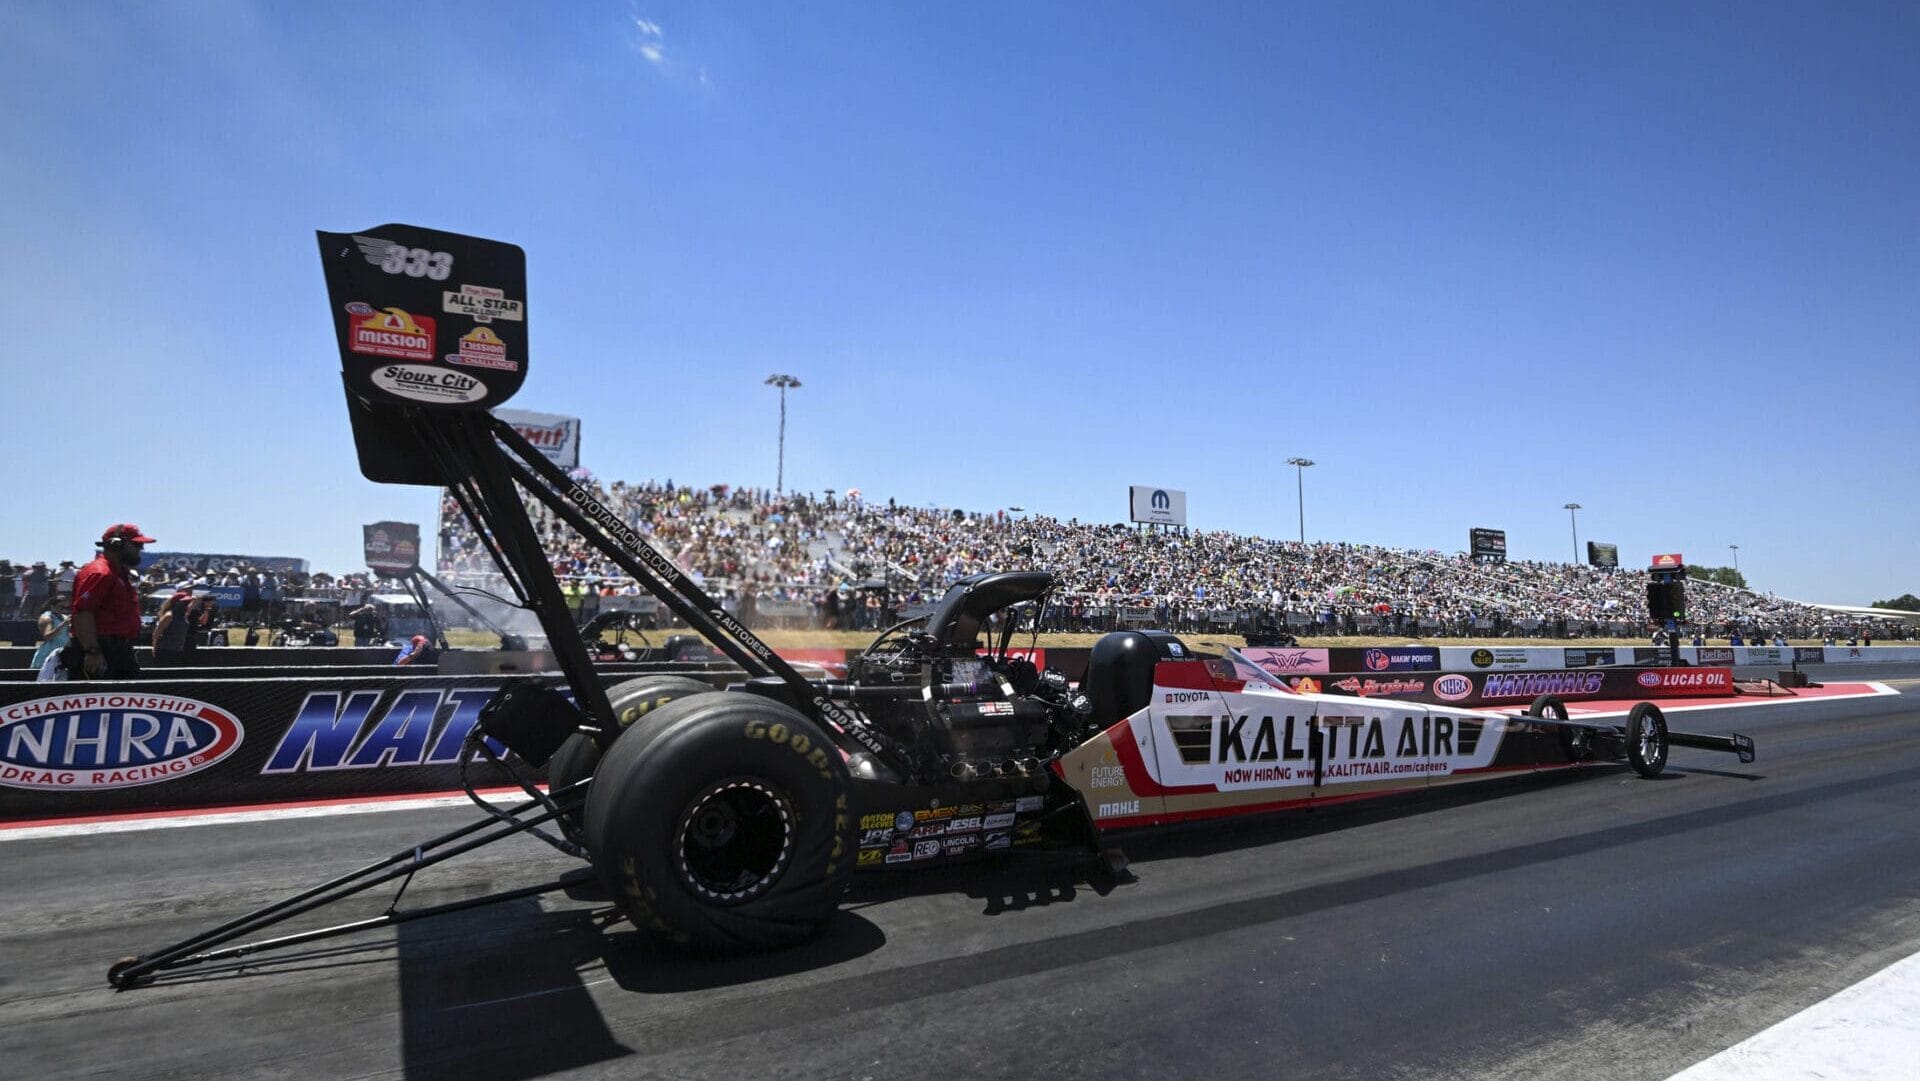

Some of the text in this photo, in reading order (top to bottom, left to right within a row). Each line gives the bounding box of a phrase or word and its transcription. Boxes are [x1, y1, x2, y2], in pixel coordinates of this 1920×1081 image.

[381, 244, 454, 280] 333
[384, 366, 478, 390] Sioux City
[567, 484, 680, 584] TOYOTARACING.COM
[723, 615, 772, 660] AUTODESK
[1441, 679, 1467, 695] NHRA
[1482, 672, 1605, 699] NATIONALS
[1663, 673, 1725, 686] LUCAS OIL
[7, 696, 197, 720] CHAMPIONSHIP
[1174, 692, 1210, 703] TOYOTA
[813, 696, 883, 754] GOODYEAR
[6, 712, 198, 766] NHRA
[1218, 715, 1453, 763] KALITTA AIR
[2, 760, 186, 785] DRAG RACING
[1091, 765, 1125, 778] FUTURE
[1091, 776, 1125, 789] ENERGY
[1224, 761, 1448, 784] NOW HIRING ww.KALITTAAIR.com/careers
[1099, 800, 1140, 817] MAHLE
[946, 817, 982, 832] JESEL
[942, 836, 976, 847] LINCOLN
